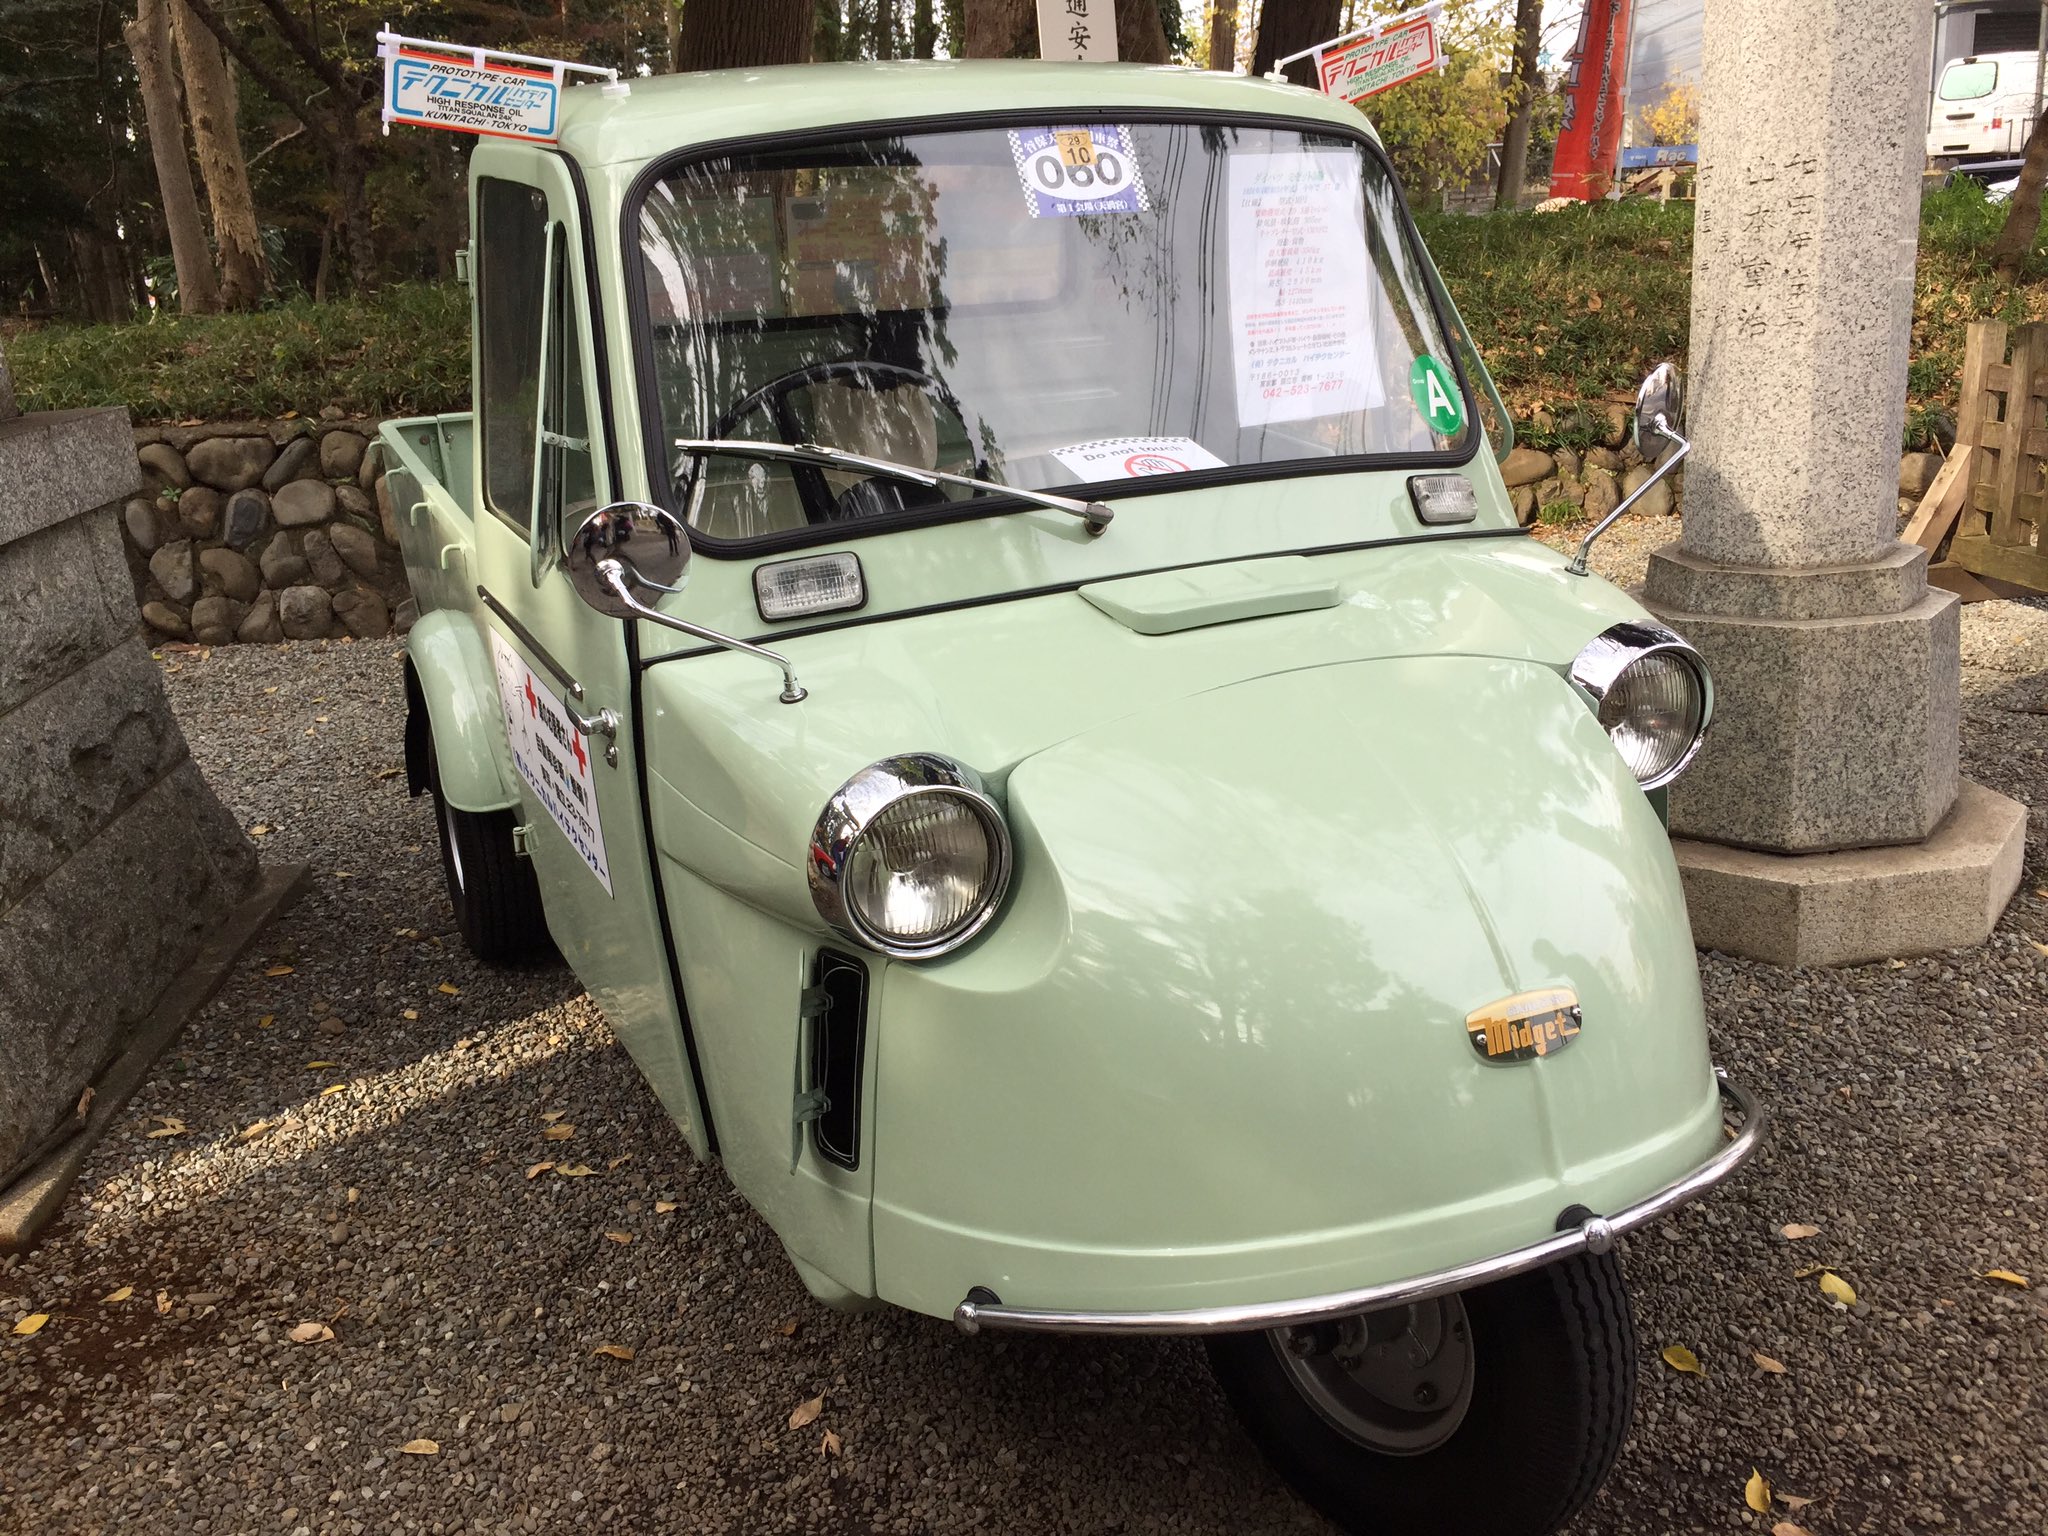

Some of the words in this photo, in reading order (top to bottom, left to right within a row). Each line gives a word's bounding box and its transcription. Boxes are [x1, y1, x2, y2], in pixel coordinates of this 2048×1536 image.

[1066, 0, 1091, 60] 通安
[401, 70, 507, 105] テクニカル
[502, 75, 526, 87] CAR
[427, 95, 451, 106] HIGH
[454, 100, 505, 114] RESPONSE
[508, 107, 524, 117] OIL
[437, 104, 460, 114] TITAN
[461, 107, 498, 120] SQUALAN
[491, 120, 528, 132] TOKYO
[1068, 136, 1080, 146] 29
[1067, 147, 1091, 164] 10
[1263, 380, 1343, 399] 042-523-7677
[1426, 369, 1456, 418] A
[1083, 453, 1106, 462] Do
[1110, 448, 1135, 457] not
[1468, 1011, 1580, 1056] Midget
